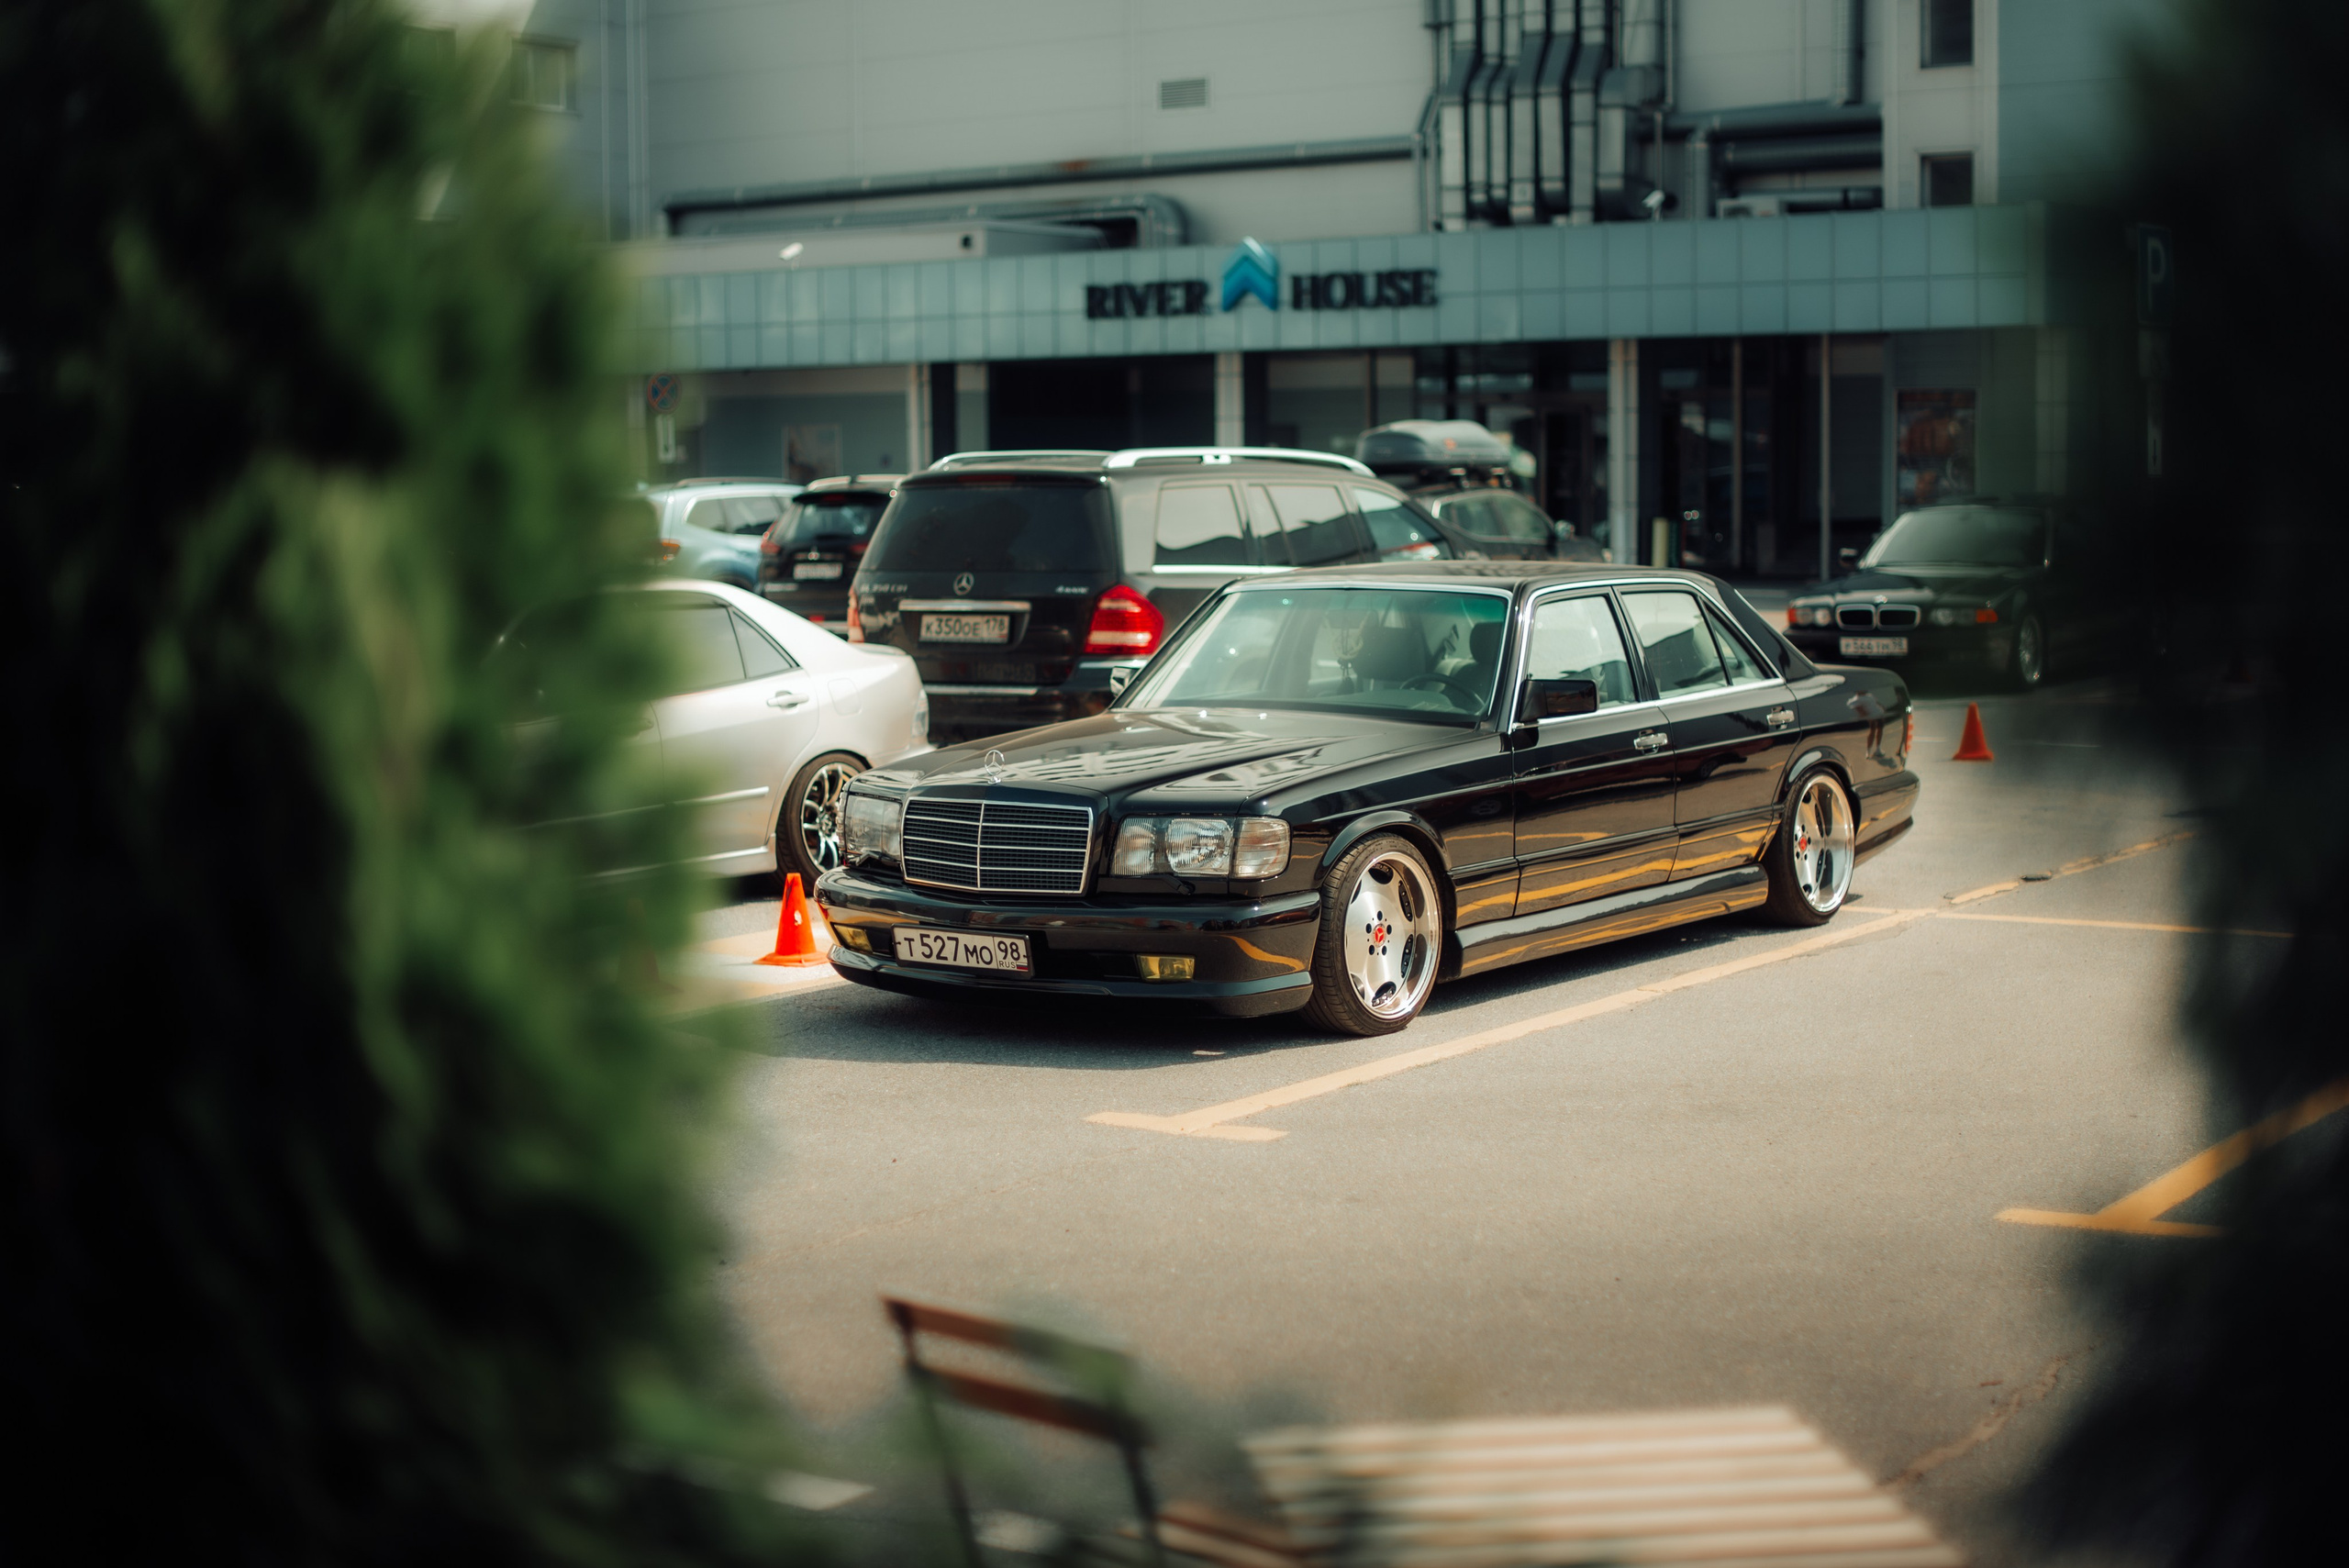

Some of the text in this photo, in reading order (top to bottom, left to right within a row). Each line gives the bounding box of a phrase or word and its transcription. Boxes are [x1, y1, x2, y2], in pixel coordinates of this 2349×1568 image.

[2146, 237, 2166, 313] P
[1085, 269, 1439, 318] RIVER HOUSE
[997, 940, 1020, 961] 98
[998, 961, 1016, 969] RUS
